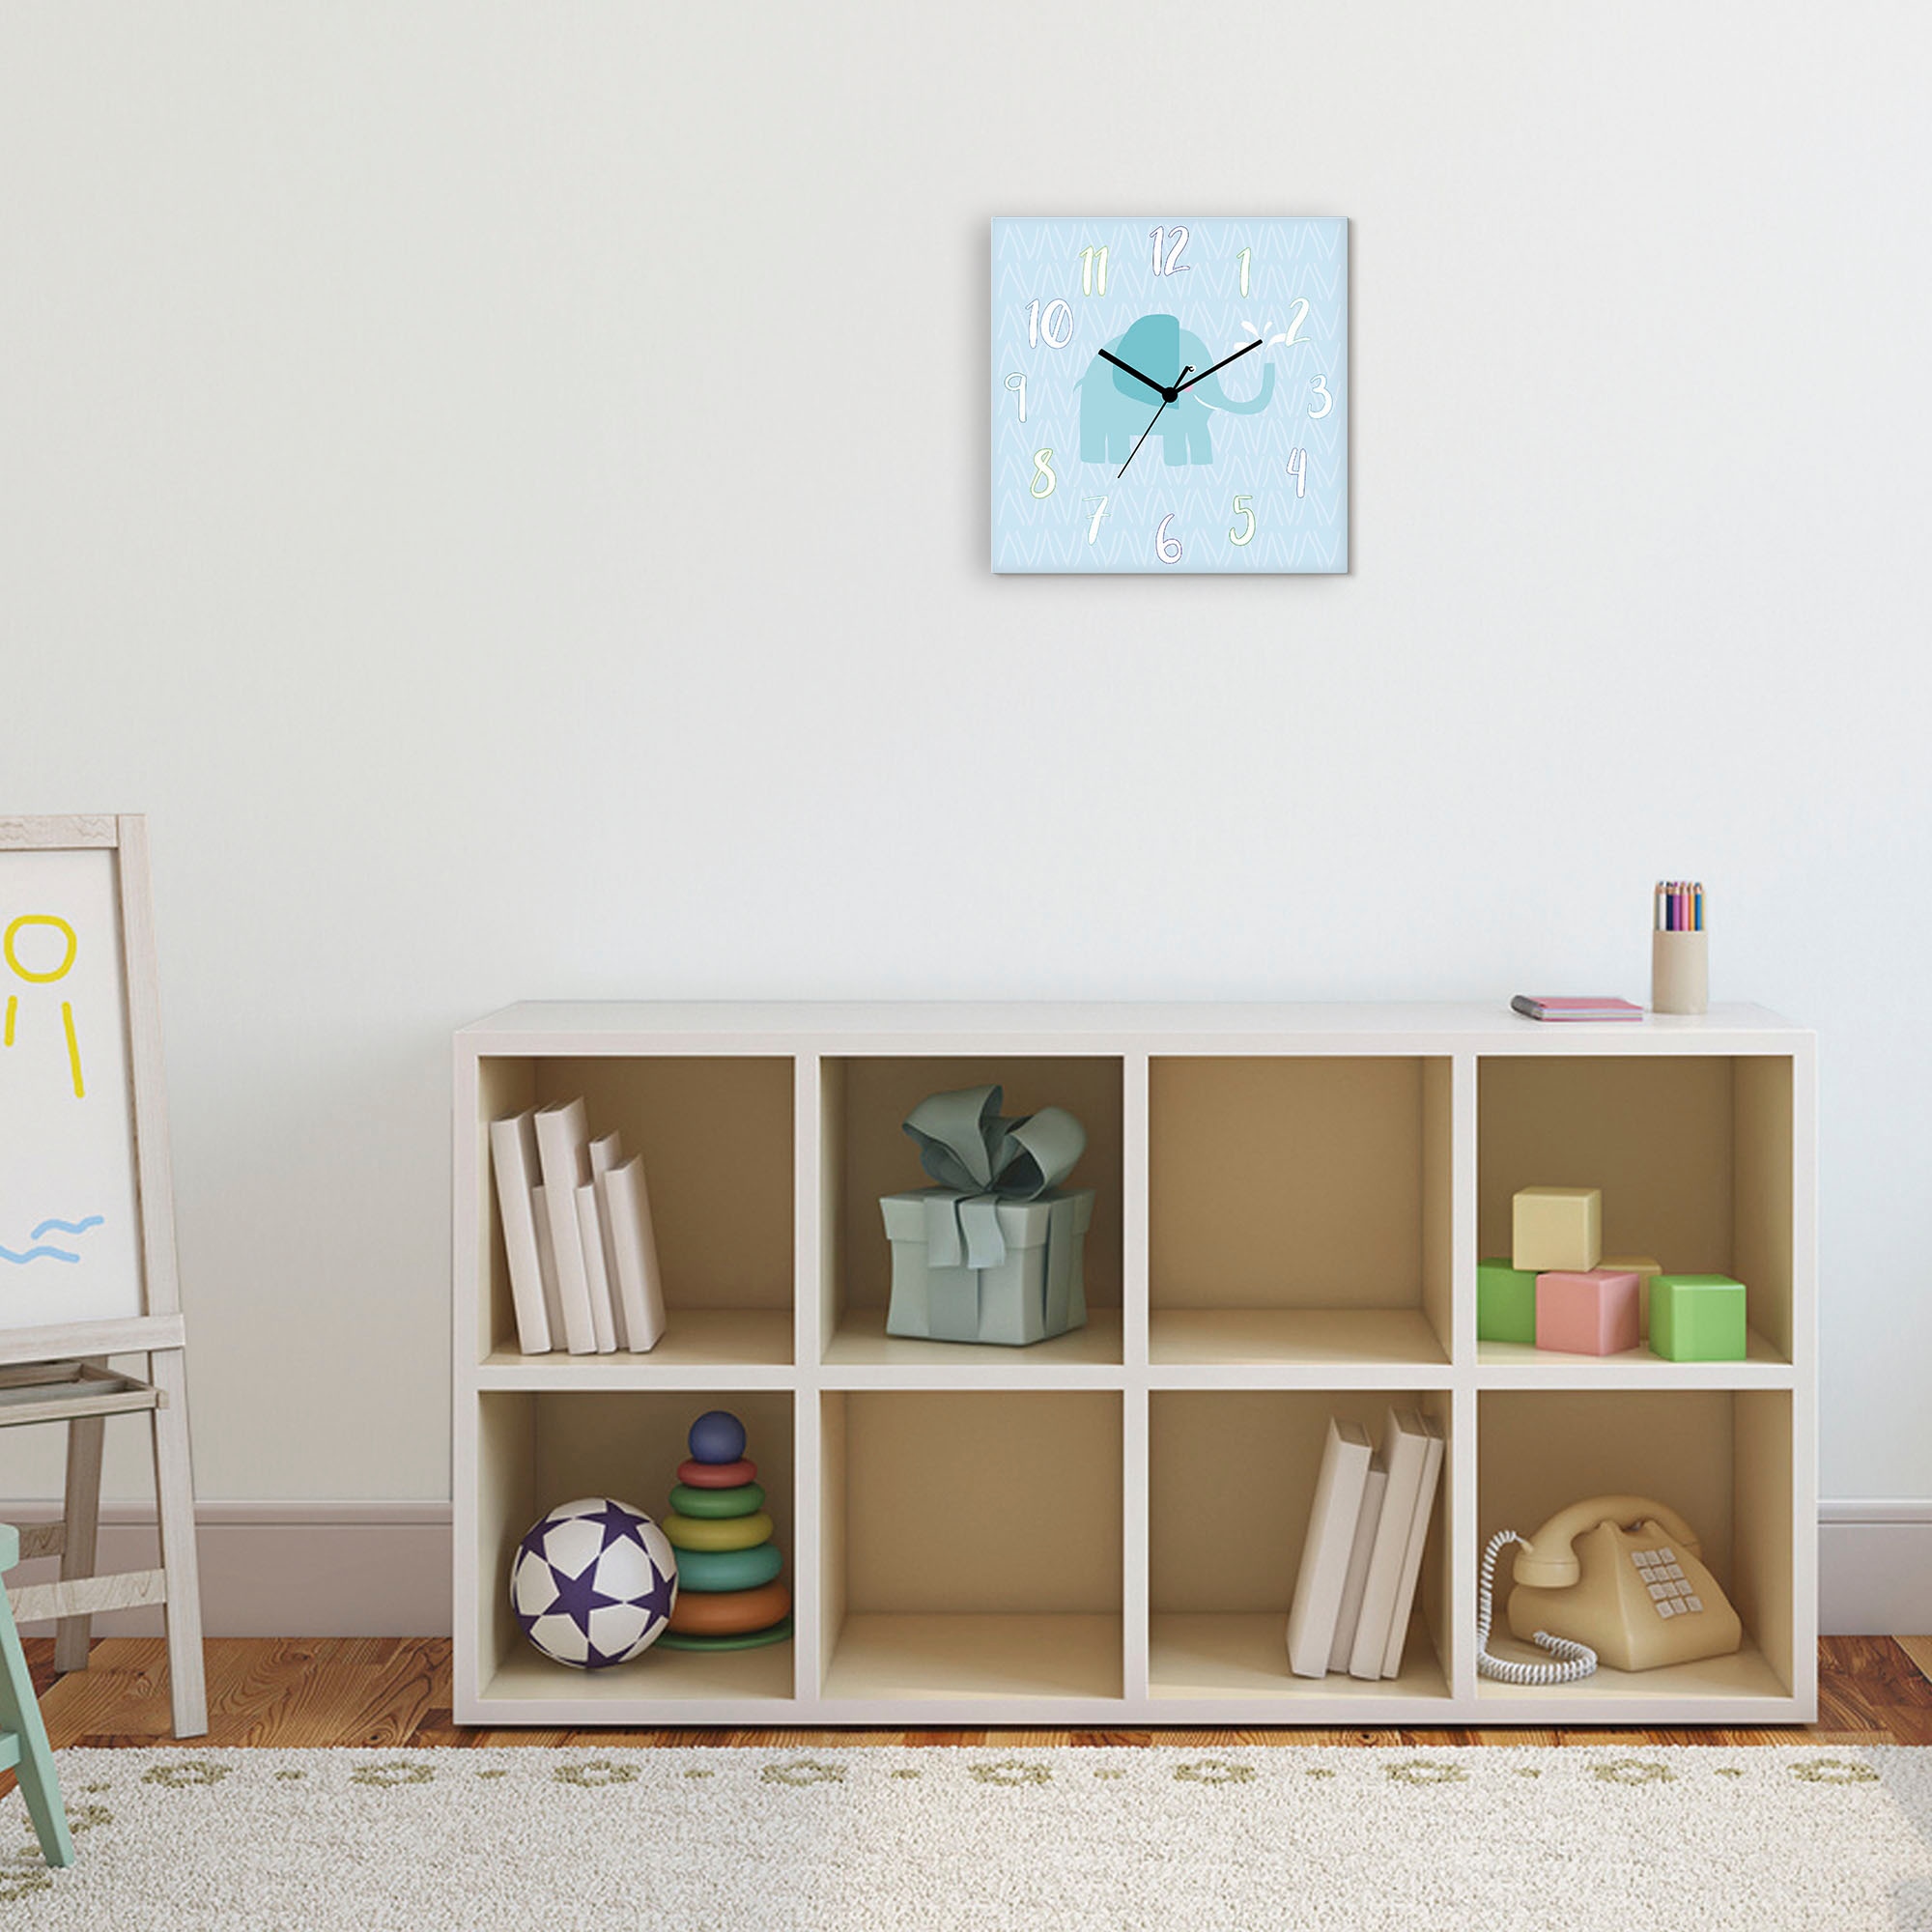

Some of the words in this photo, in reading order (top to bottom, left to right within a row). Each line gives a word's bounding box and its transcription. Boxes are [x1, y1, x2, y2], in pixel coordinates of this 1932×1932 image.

[1079, 245, 1109, 297] 11
[1149, 225, 1190, 276] 12
[1236, 247, 1251, 298] 1
[1025, 298, 1074, 349] 10
[1286, 297, 1312, 347] 2
[1004, 372, 1027, 423] 9
[1307, 374, 1333, 419] 3
[1030, 448, 1057, 498] 8
[1286, 447, 1307, 498] 4
[1082, 495, 1111, 546] 7
[1155, 513, 1182, 564] 6
[1229, 495, 1256, 547] 5
